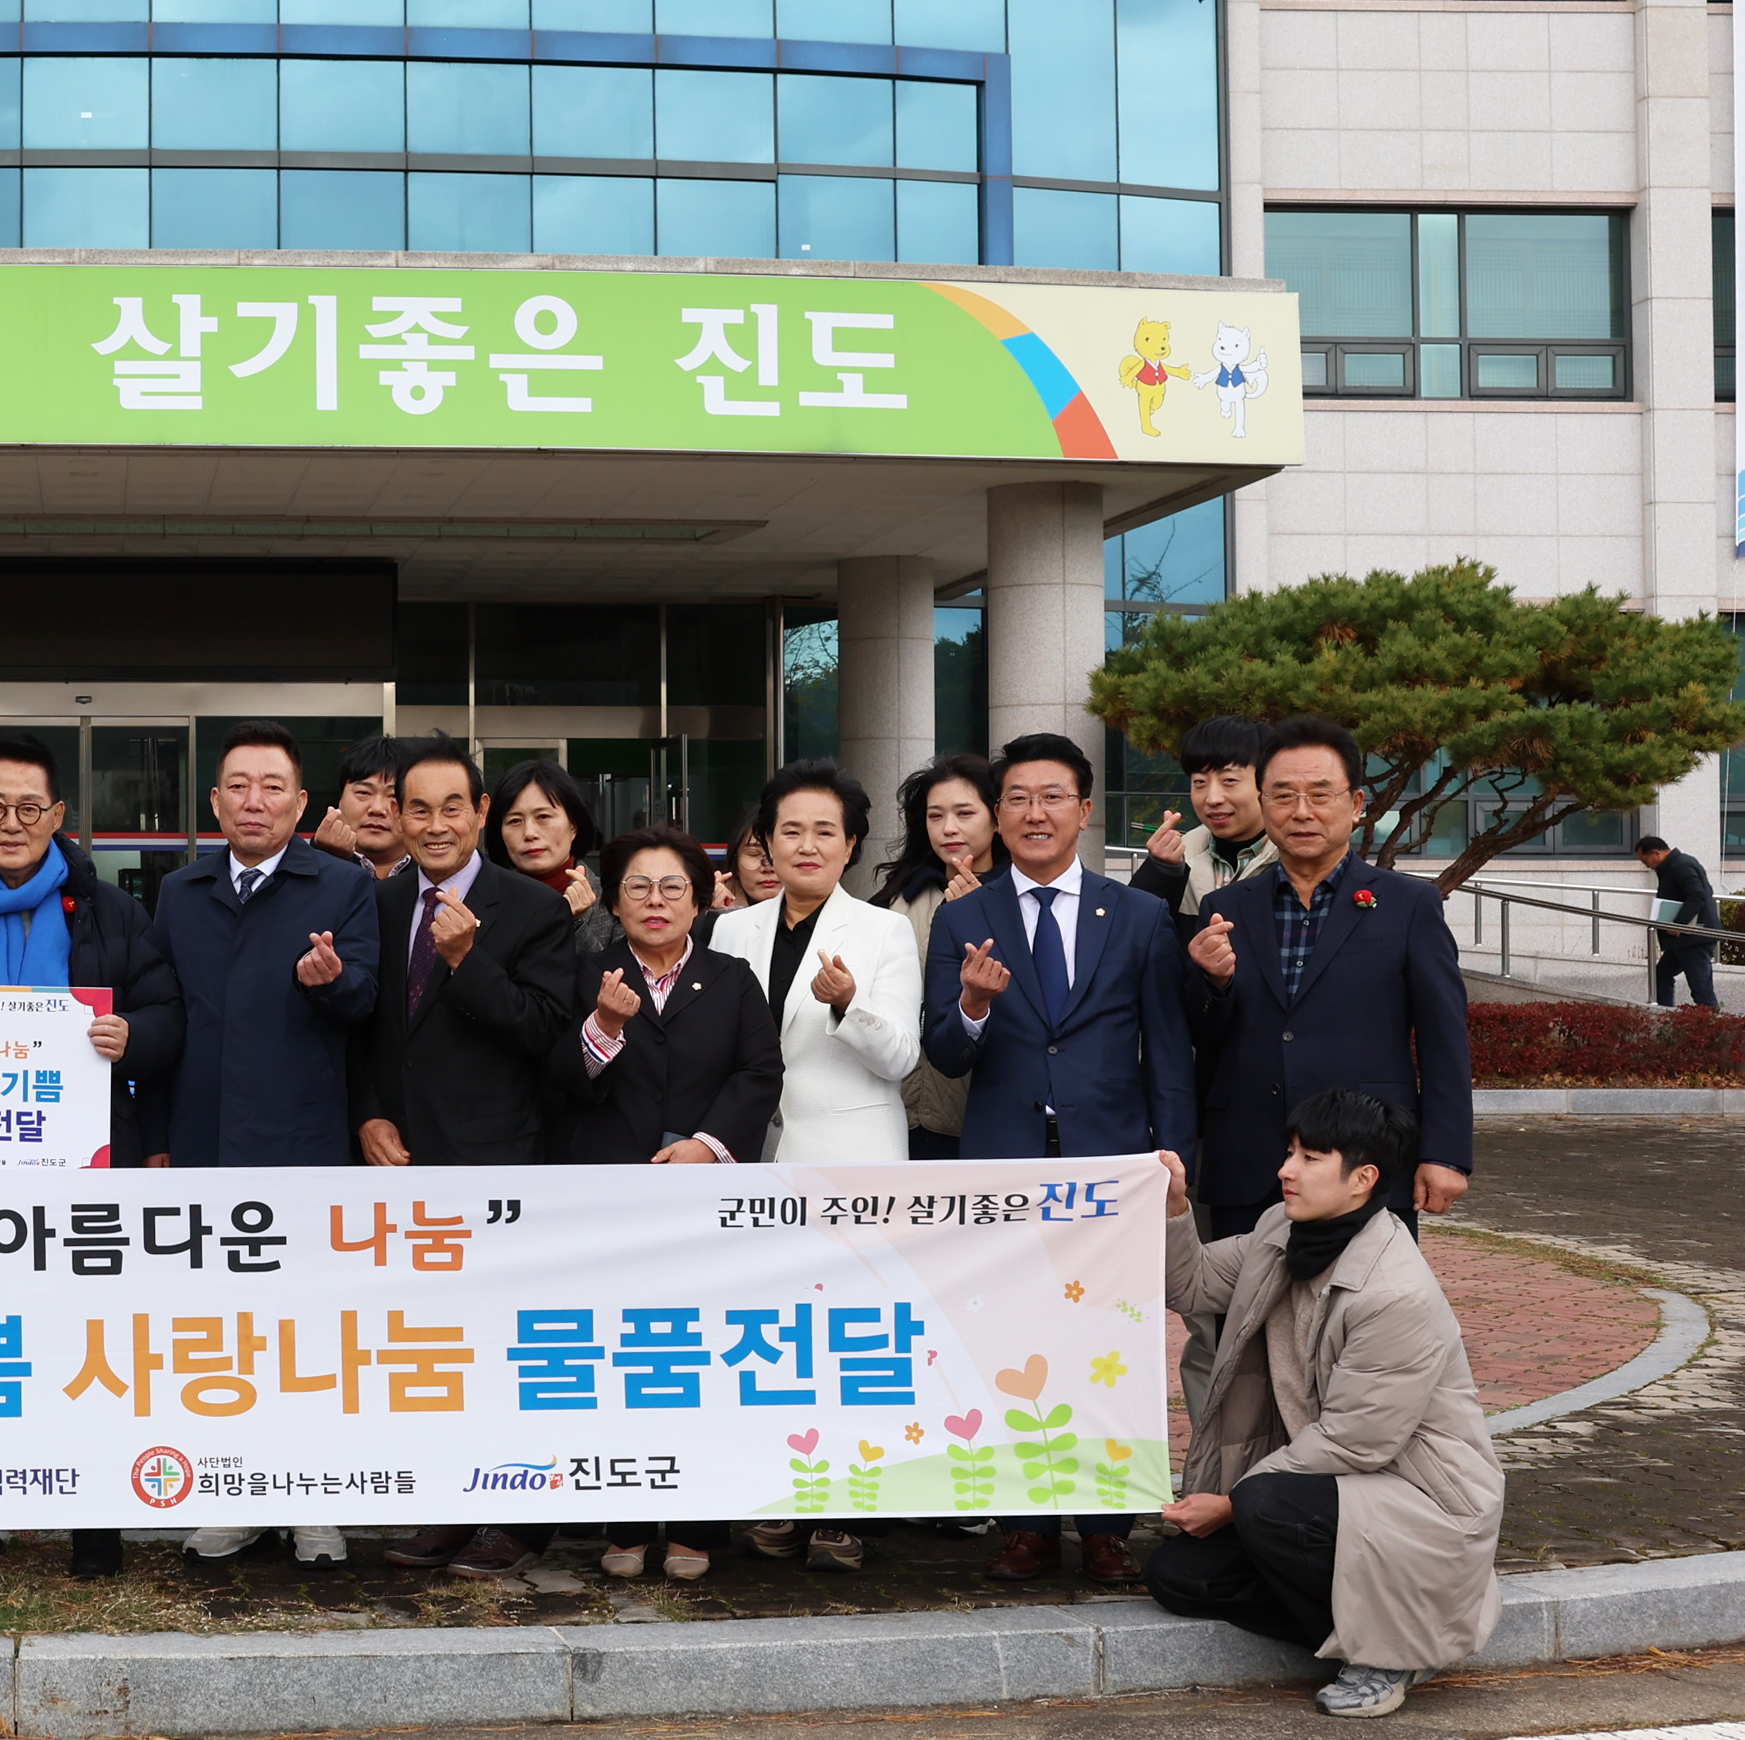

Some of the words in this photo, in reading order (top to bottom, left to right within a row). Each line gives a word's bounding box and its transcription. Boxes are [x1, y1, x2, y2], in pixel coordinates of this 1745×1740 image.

[91, 294, 604, 415] 살기좋은
[674, 303, 909, 416] 진도
[46, 999, 68, 1012] 진도
[1, 1070, 63, 1103] 기쁨
[41, 1158, 66, 1167] 진도군
[718, 1197, 806, 1227] 군민이
[821, 1196, 895, 1225] 주인!
[907, 1194, 1029, 1225] 살기좋은
[1037, 1180, 1119, 1221] 진도
[330, 1200, 521, 1271] 나눔”
[62, 1310, 475, 1417] 사랑나눔
[507, 1302, 925, 1410] 물품전달
[198, 1457, 242, 1468] 사단법인
[569, 1456, 680, 1490] 진도군
[198, 1471, 416, 1496] 희망을나누는사람들
[463, 1468, 546, 1492] Jindo
